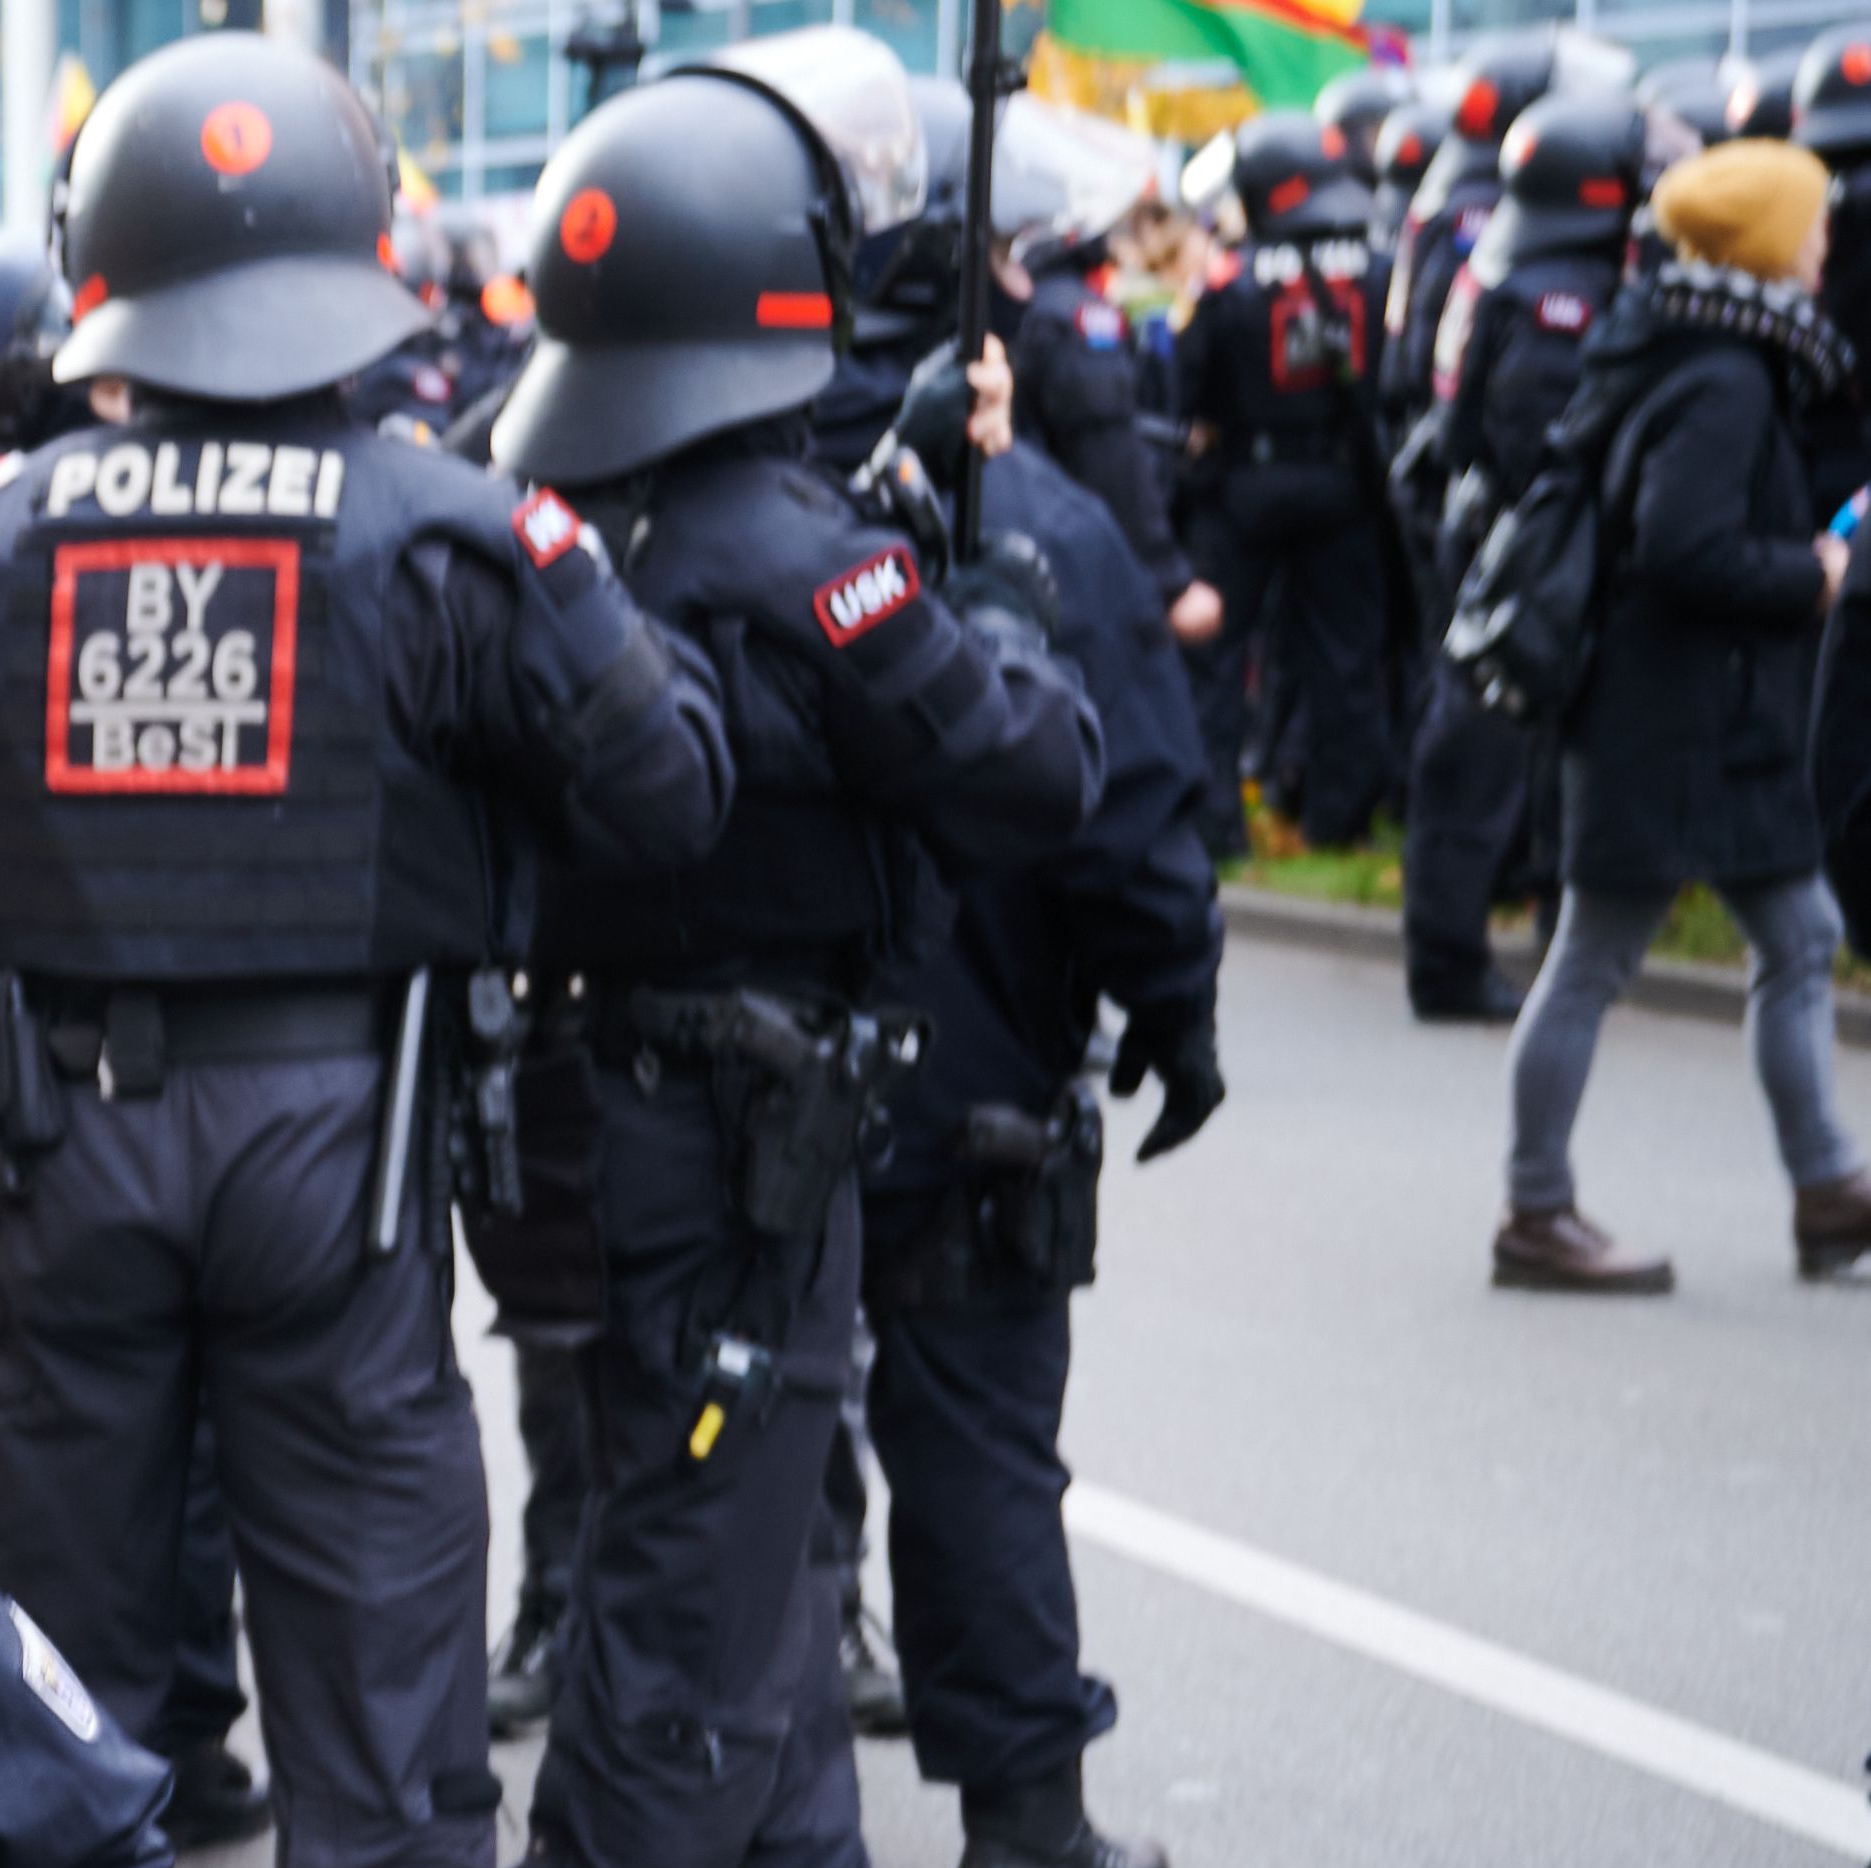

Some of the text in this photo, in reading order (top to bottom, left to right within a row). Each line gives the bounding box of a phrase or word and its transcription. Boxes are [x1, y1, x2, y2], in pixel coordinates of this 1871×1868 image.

[47, 441, 345, 518] POLIZEI
[126, 560, 225, 635] BY
[829, 553, 907, 630] USK
[77, 630, 259, 702] 6226
